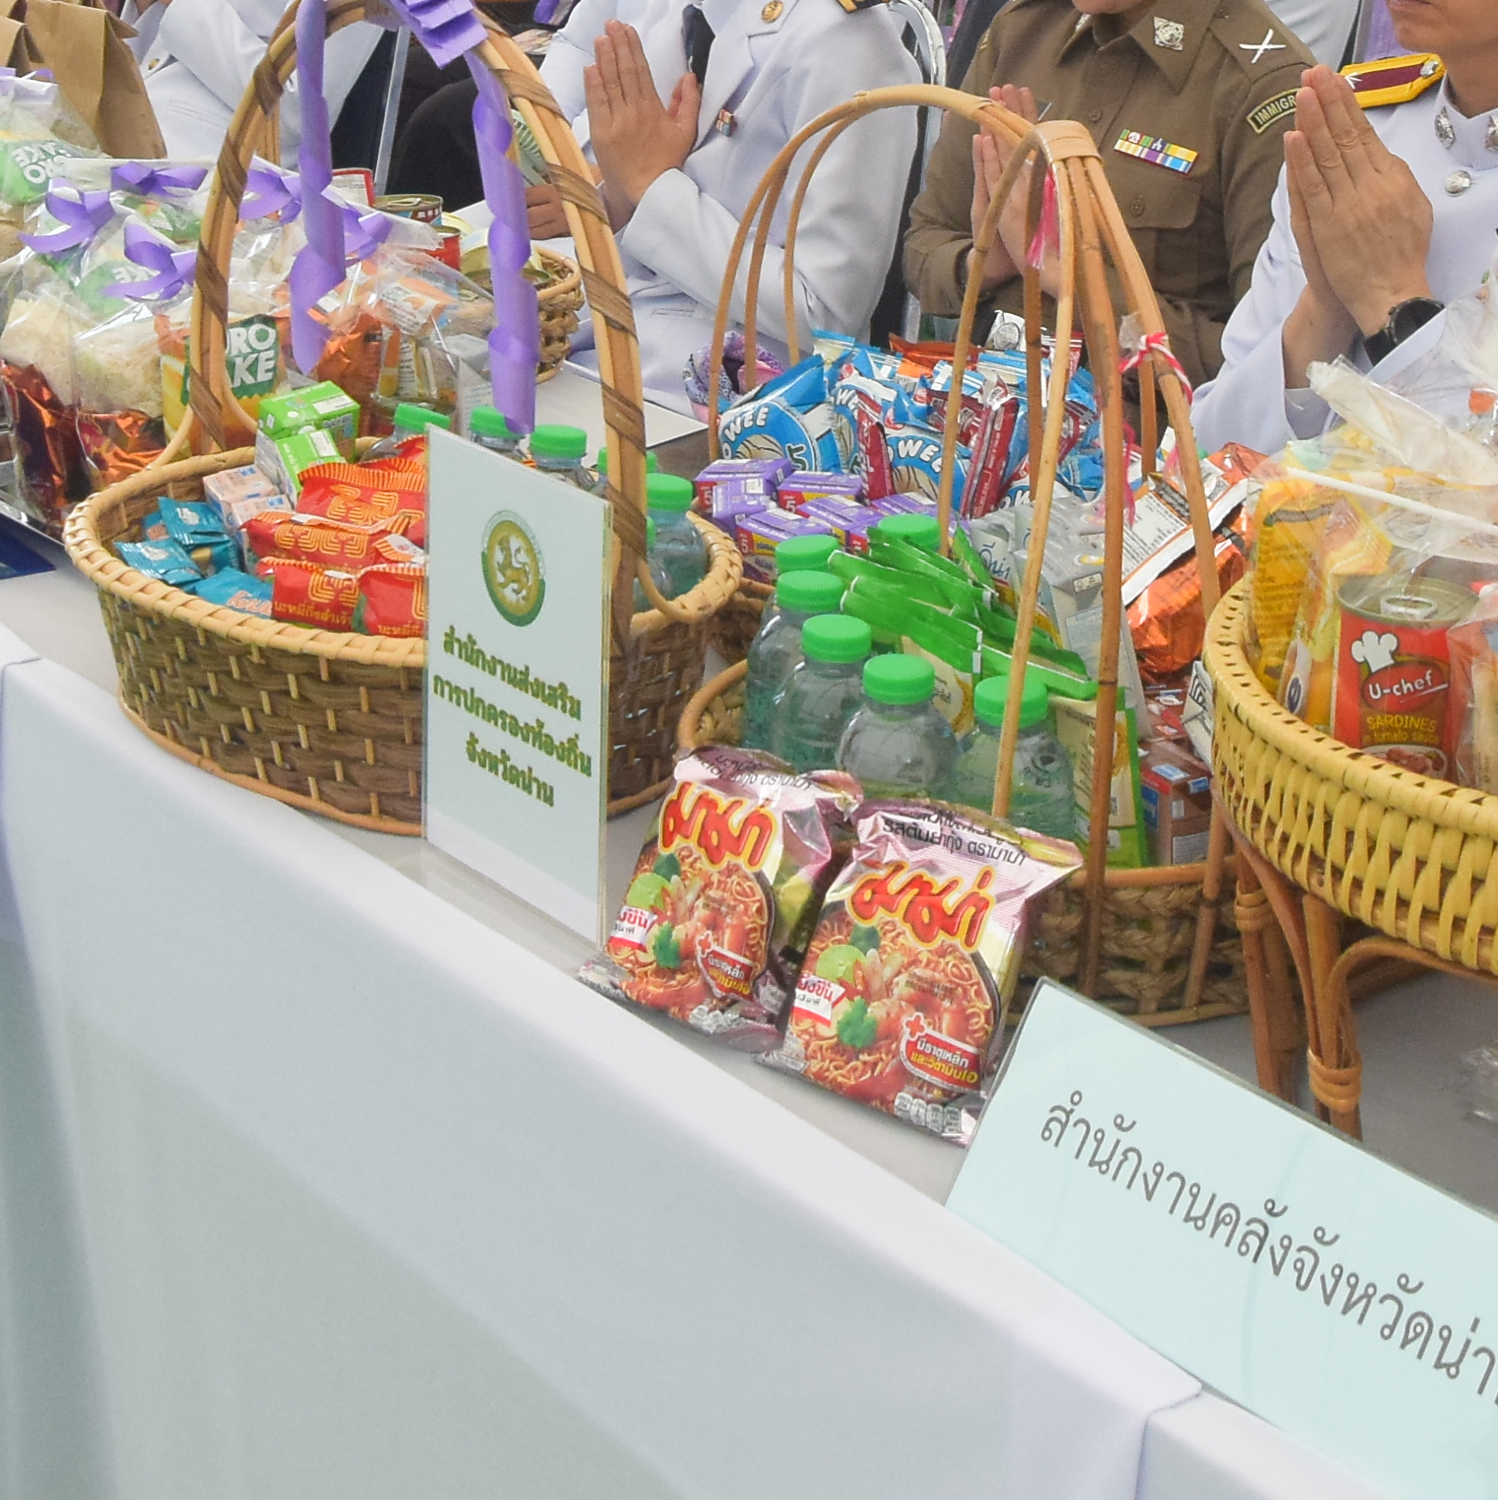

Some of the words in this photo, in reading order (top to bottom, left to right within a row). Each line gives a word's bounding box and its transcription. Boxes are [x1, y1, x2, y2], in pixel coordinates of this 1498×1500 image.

[1254, 95, 1298, 125] IMMIGR
[443, 624, 582, 722] สำนักงานส่งเสริม
[1369, 669, 1433, 700] U-chef
[432, 674, 593, 778] การปกครองท้องถิ่น
[1366, 714, 1437, 733] SARDINES
[466, 731, 555, 807] จังหวัดน่าน
[660, 781, 778, 873] มาม่า
[847, 859, 995, 951] มาม่า
[909, 1050, 979, 1084] และวิตามินเอ
[916, 1036, 969, 1067] มีธาตุเหล็ก
